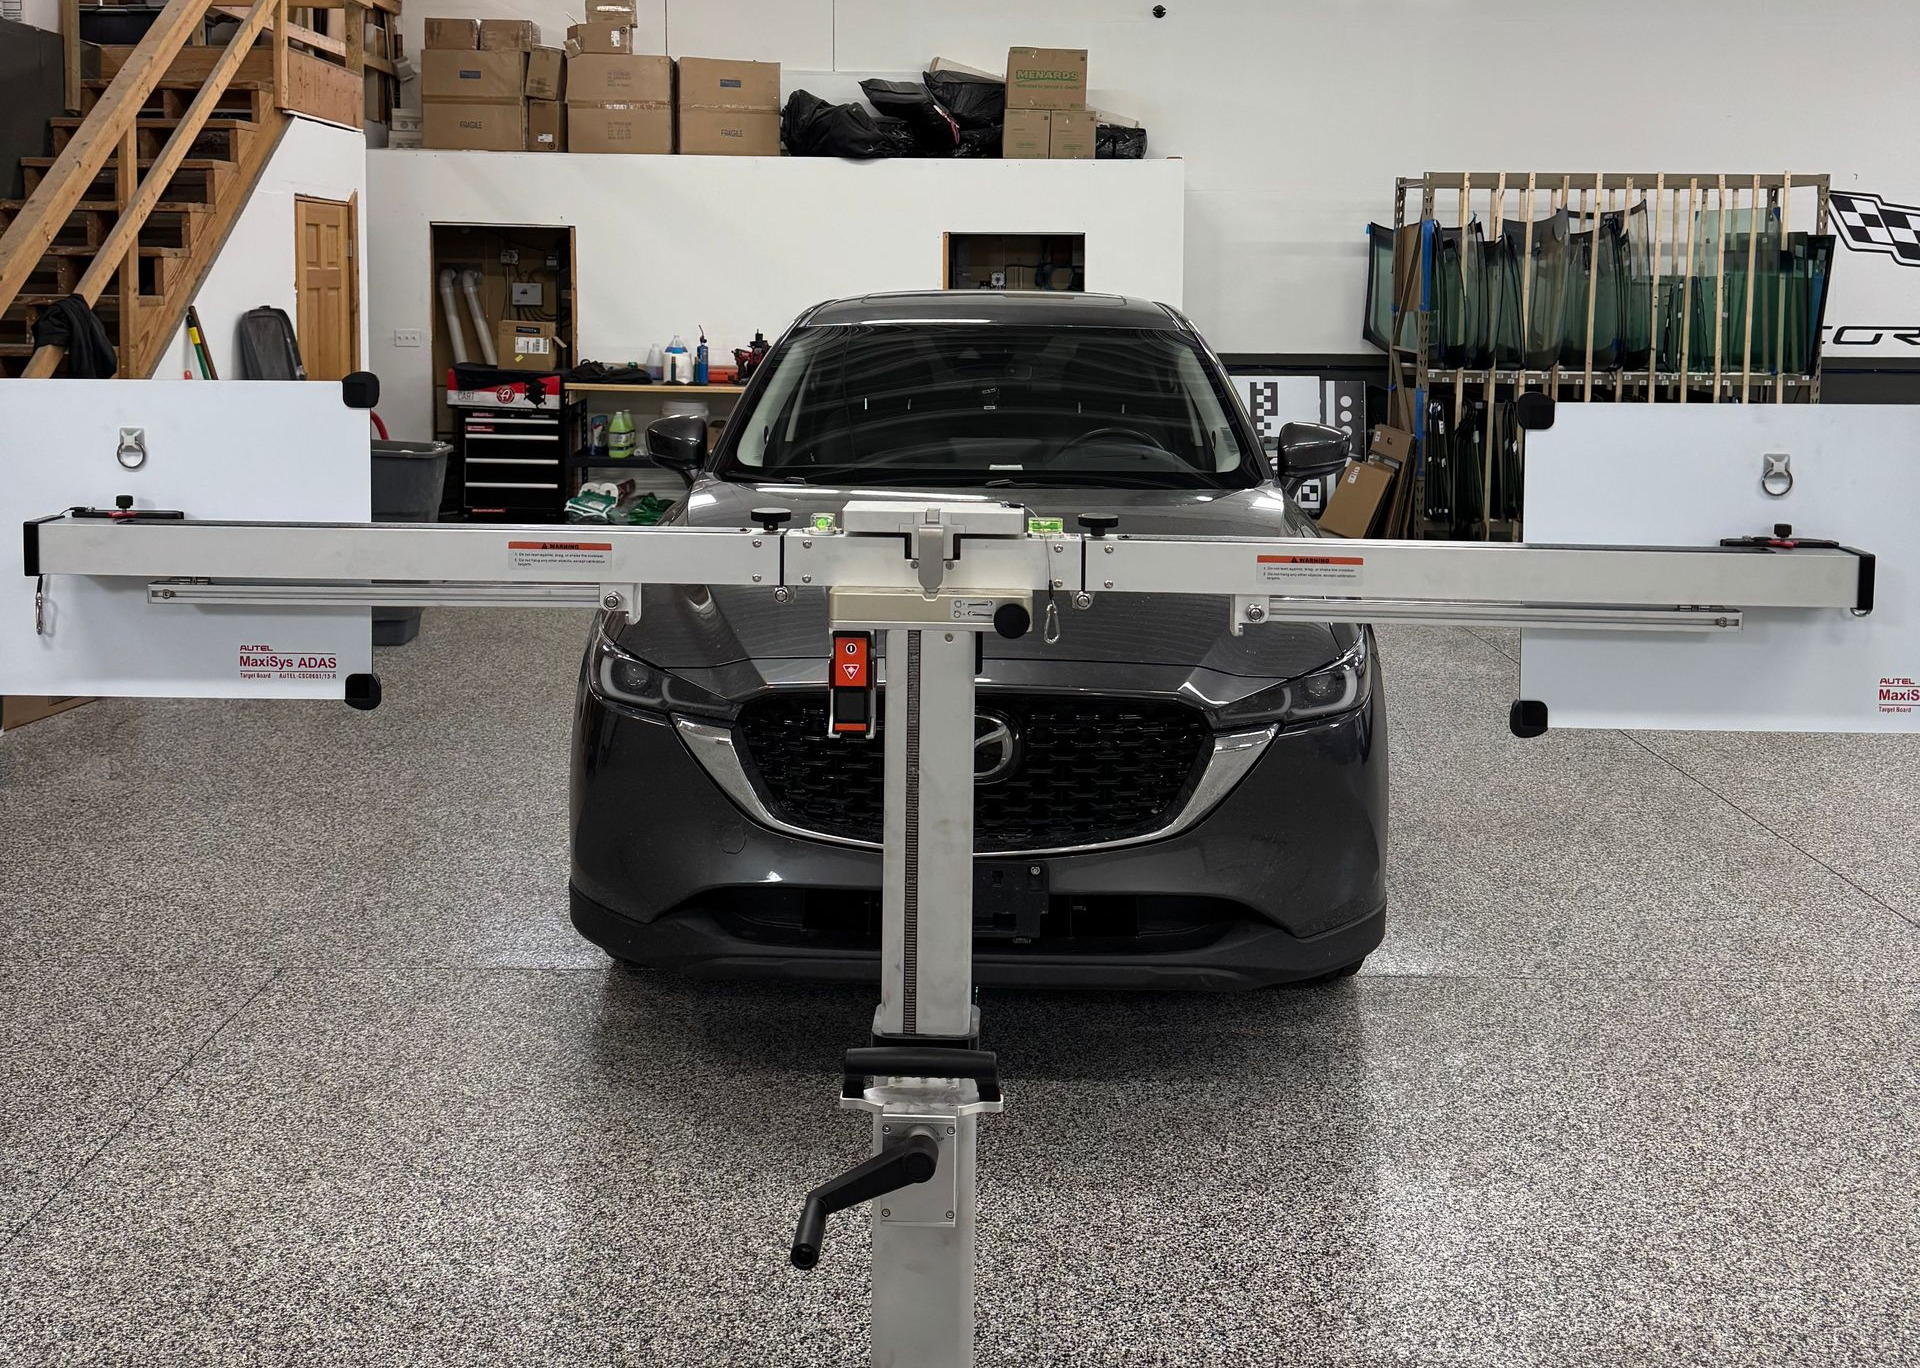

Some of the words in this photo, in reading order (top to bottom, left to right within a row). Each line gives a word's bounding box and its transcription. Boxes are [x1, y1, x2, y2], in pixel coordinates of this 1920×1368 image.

[1016, 69, 1079, 81] MENARDS
[460, 121, 482, 129] FRAGILE
[721, 129, 744, 138] FRAGILE
[240, 656, 293, 669] MaxiSys
[298, 657, 337, 668] ADAS
